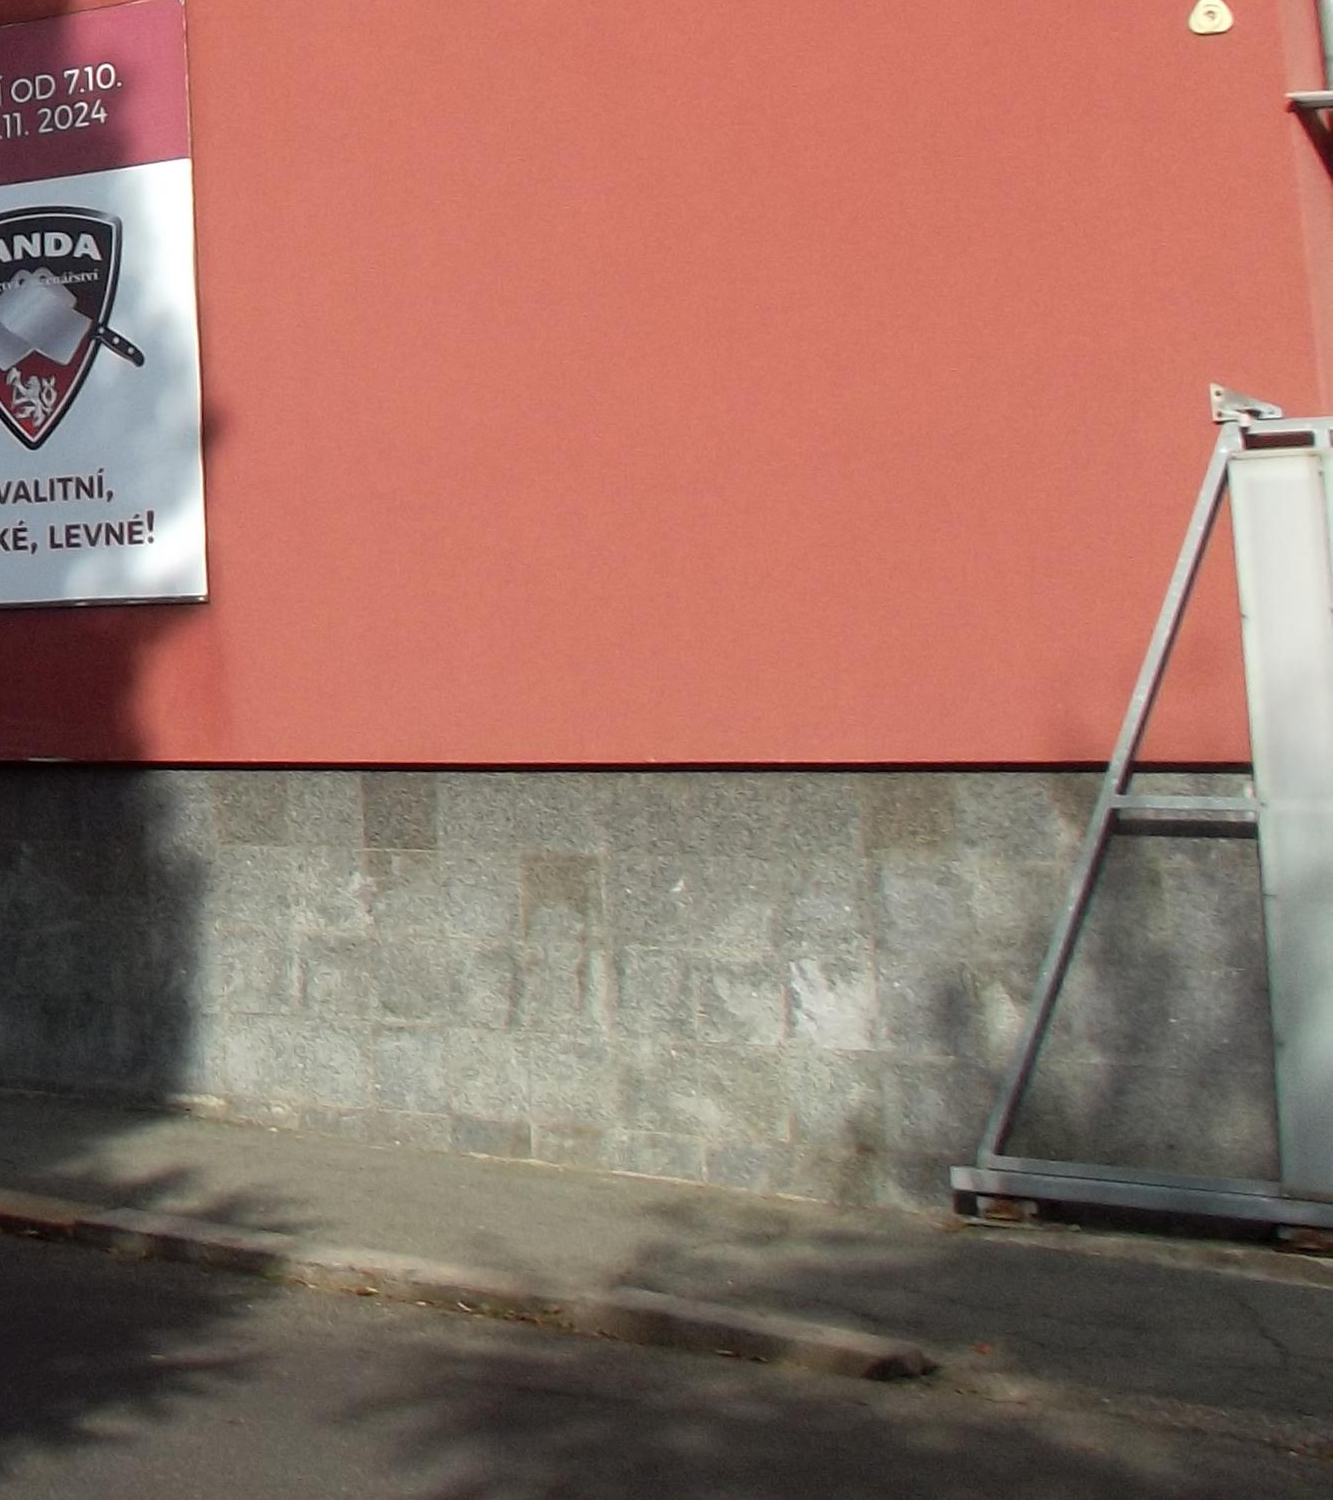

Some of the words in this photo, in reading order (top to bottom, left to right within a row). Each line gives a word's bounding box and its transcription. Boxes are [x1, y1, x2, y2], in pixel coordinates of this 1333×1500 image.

[11, 75, 55, 103] OD
[63, 63, 123, 95] 7.10.
[37, 99, 108, 133] 2024
[49, 510, 154, 549] LEVNÉ!
